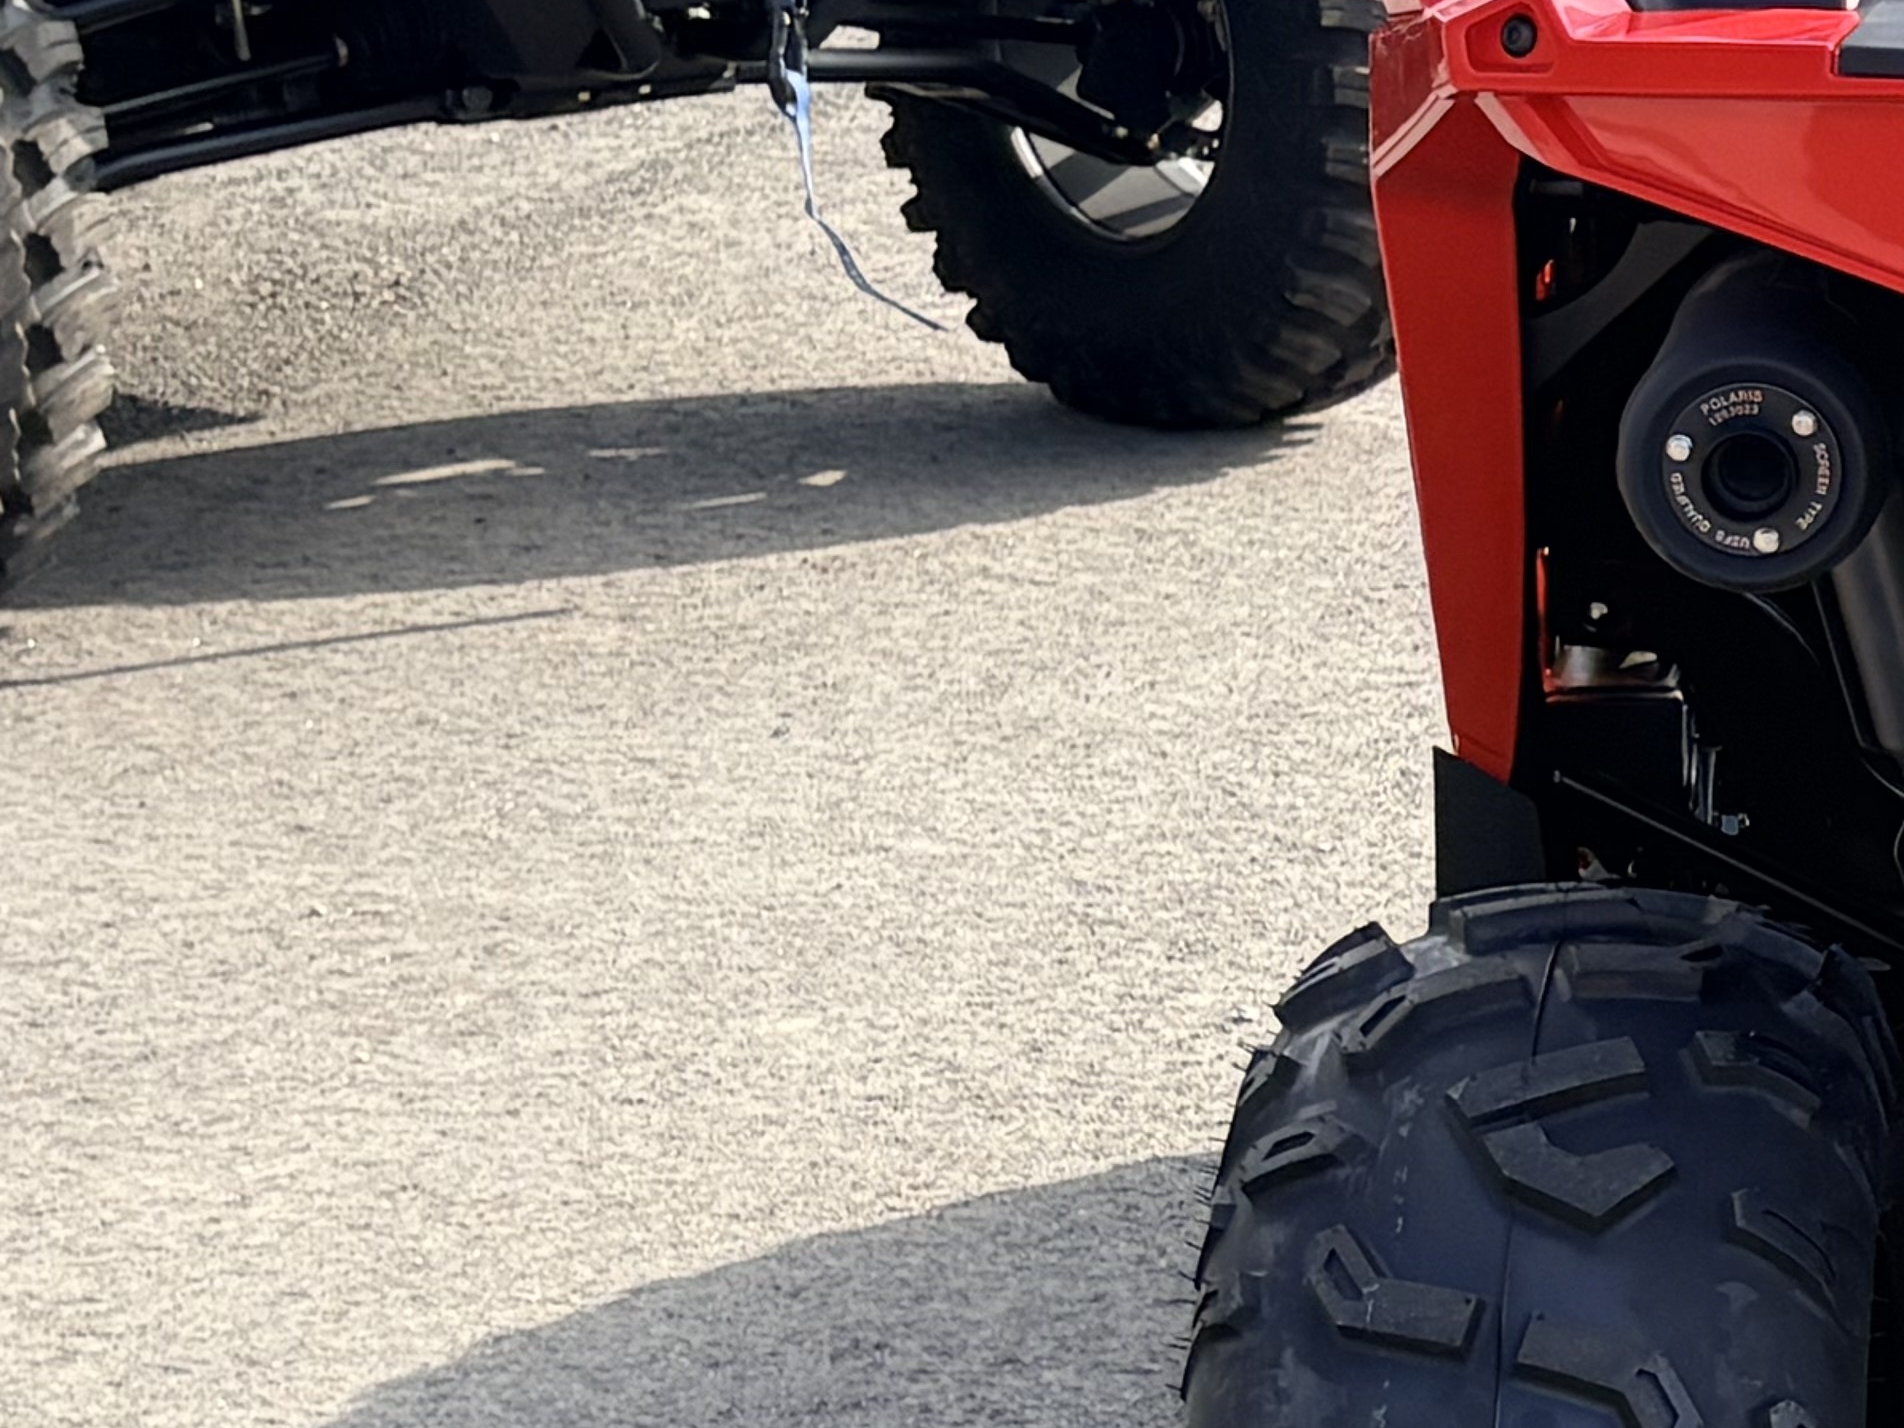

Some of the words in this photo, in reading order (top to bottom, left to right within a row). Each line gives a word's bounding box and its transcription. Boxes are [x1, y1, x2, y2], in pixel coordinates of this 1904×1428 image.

[1700, 389, 1763, 416] POLARIS
[1812, 442, 1830, 495] SCREEN
[1670, 472, 1711, 533] QUALIFIED
[1796, 501, 1823, 530] TYPE
